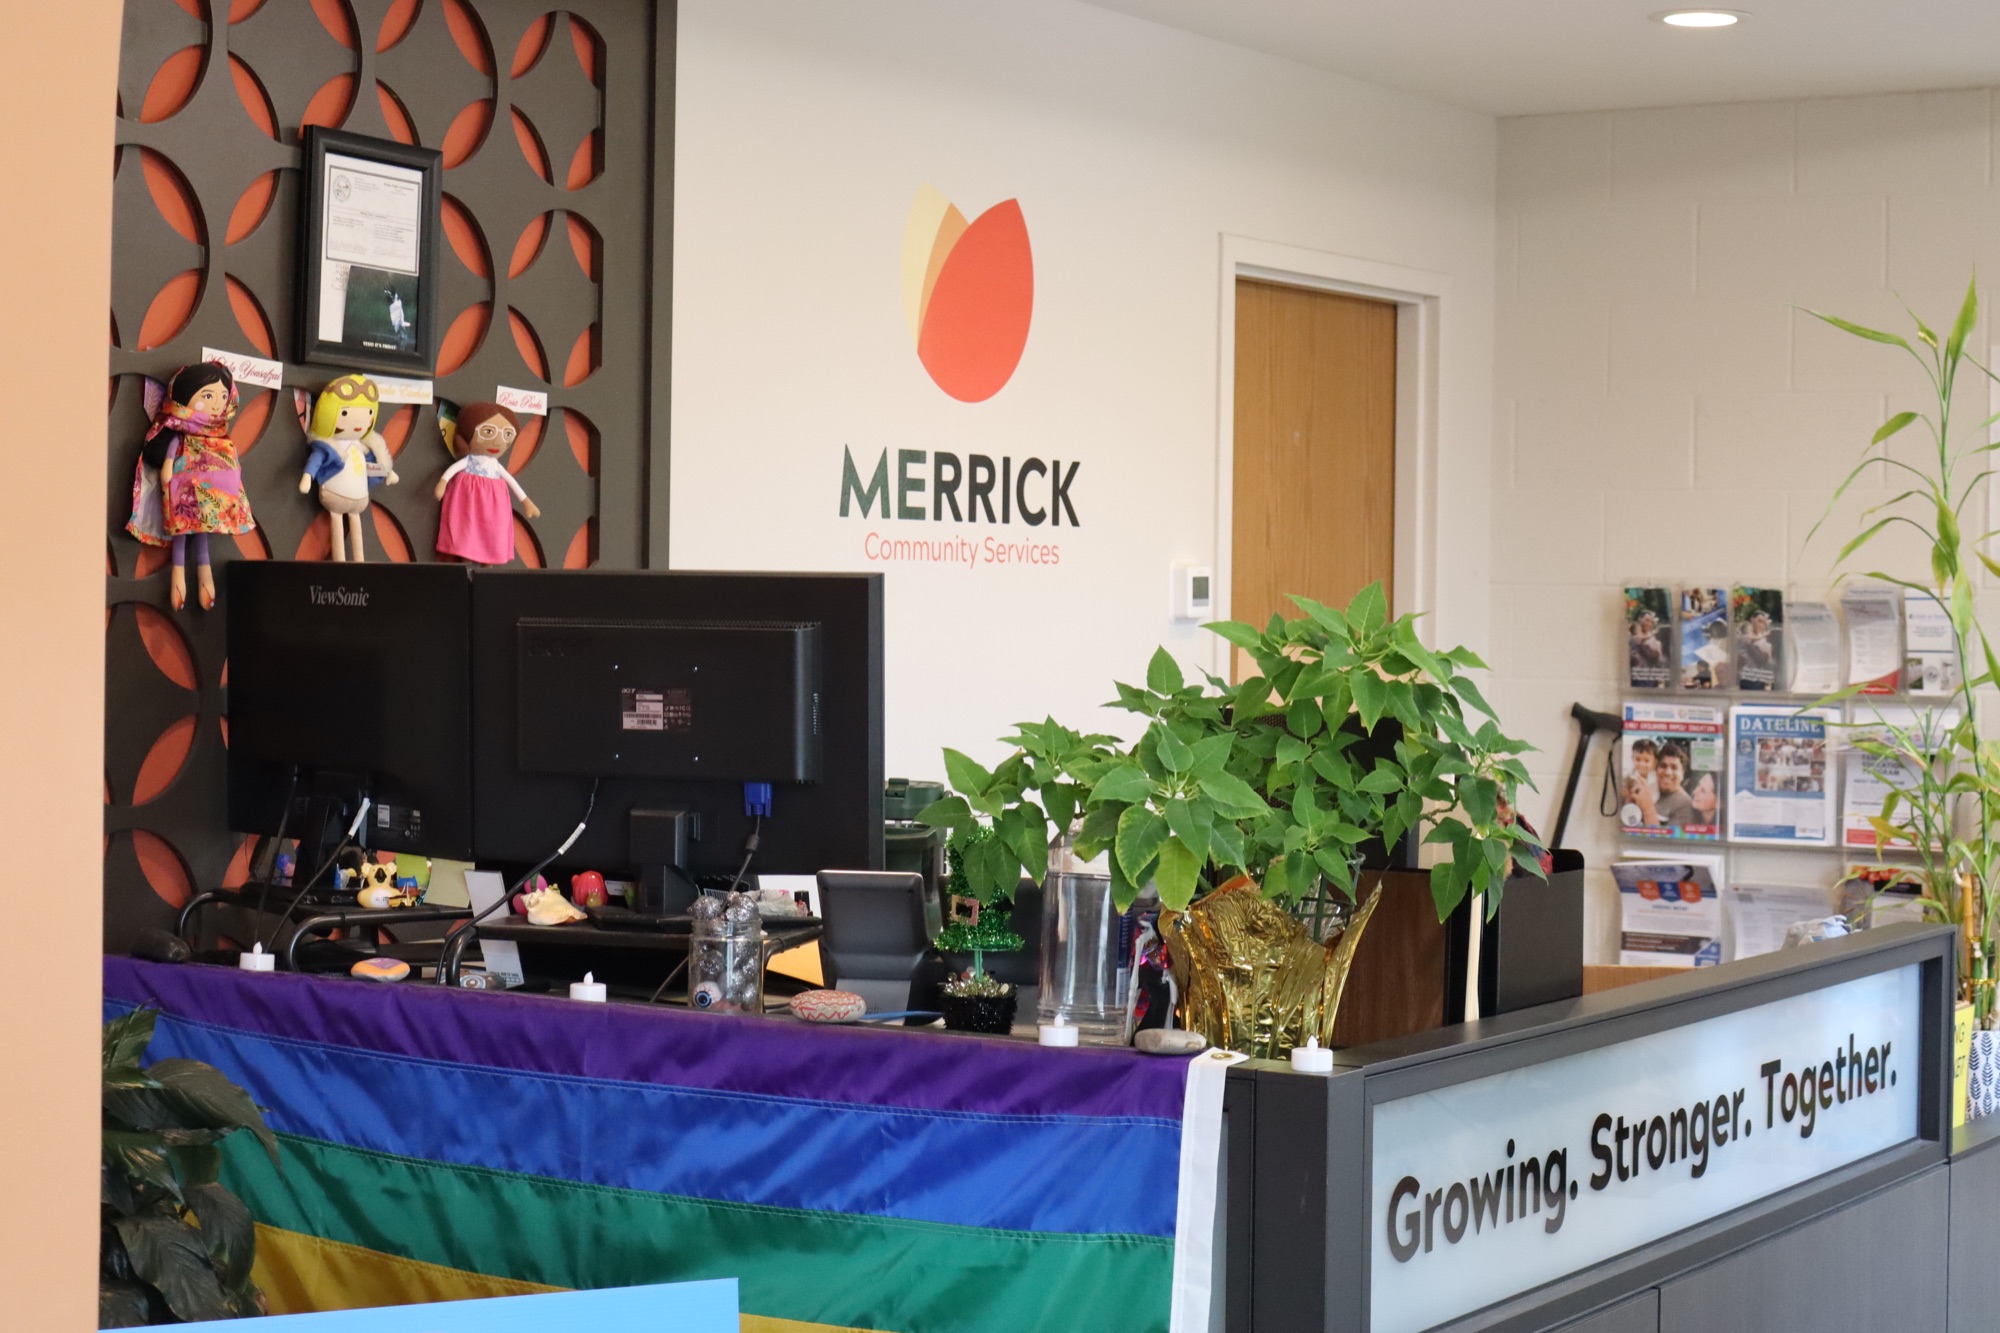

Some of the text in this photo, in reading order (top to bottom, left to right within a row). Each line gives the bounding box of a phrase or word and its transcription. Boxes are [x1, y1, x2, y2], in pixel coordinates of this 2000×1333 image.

[840, 443, 1081, 528] MERRICK
[864, 532, 1060, 569] Community Services
[310, 585, 370, 607] ViewSonic
[1740, 717, 1820, 732] DATELINE
[1387, 1033, 1897, 1263] Growing. Stronger. Together.
